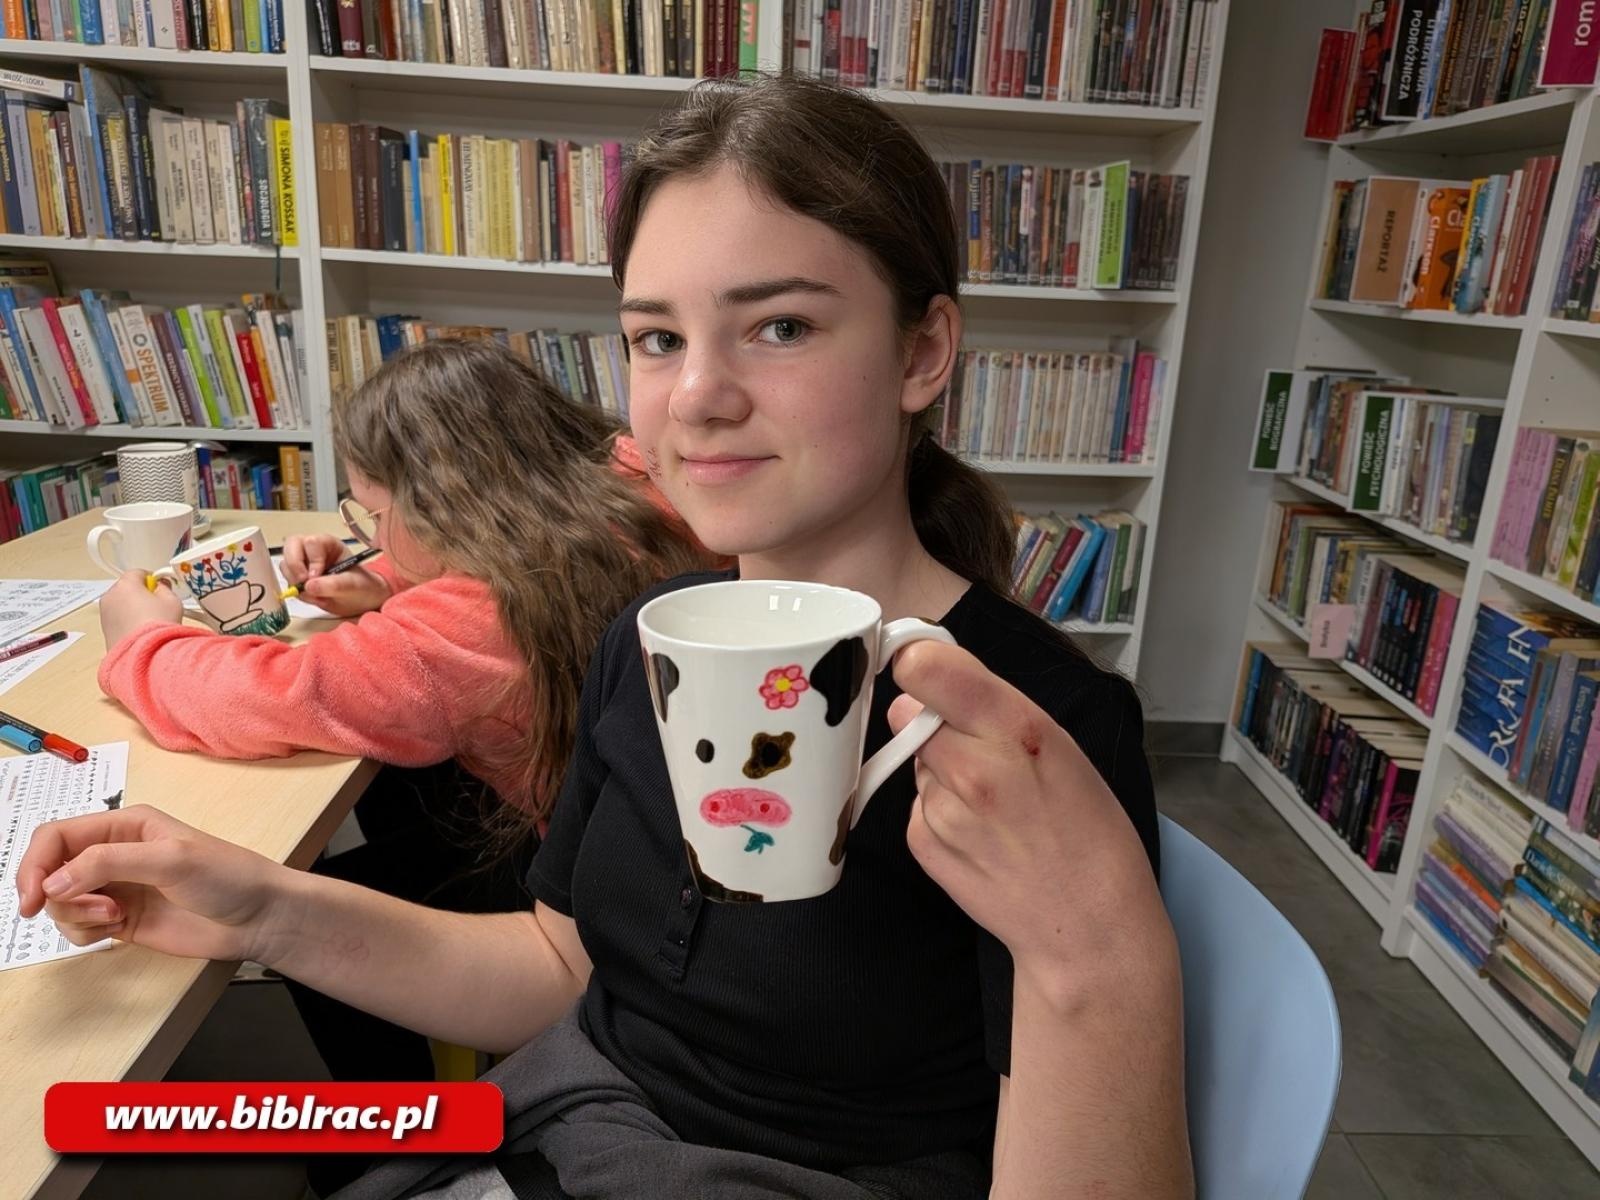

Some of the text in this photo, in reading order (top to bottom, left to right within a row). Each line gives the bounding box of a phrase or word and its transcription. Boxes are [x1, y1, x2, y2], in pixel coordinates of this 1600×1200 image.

[1398, 9, 1424, 101] PODRÓŻNICZA
[259, 179, 270, 228] SOCJOLOGIA
[280, 148, 294, 233] SIMONA KOSSAK
[1377, 210, 1396, 274] REPORTAŻ
[1421, 216, 1440, 276] Clarkson
[137, 349, 168, 412] SPEKTRUM
[1261, 400, 1276, 439] POWIEŚĆ
[1269, 391, 1287, 451] BIOGRAFICZNA
[1359, 431, 1376, 474] POWIEŚĆ
[1369, 410, 1389, 497] PSYCHOLOGICZNA
